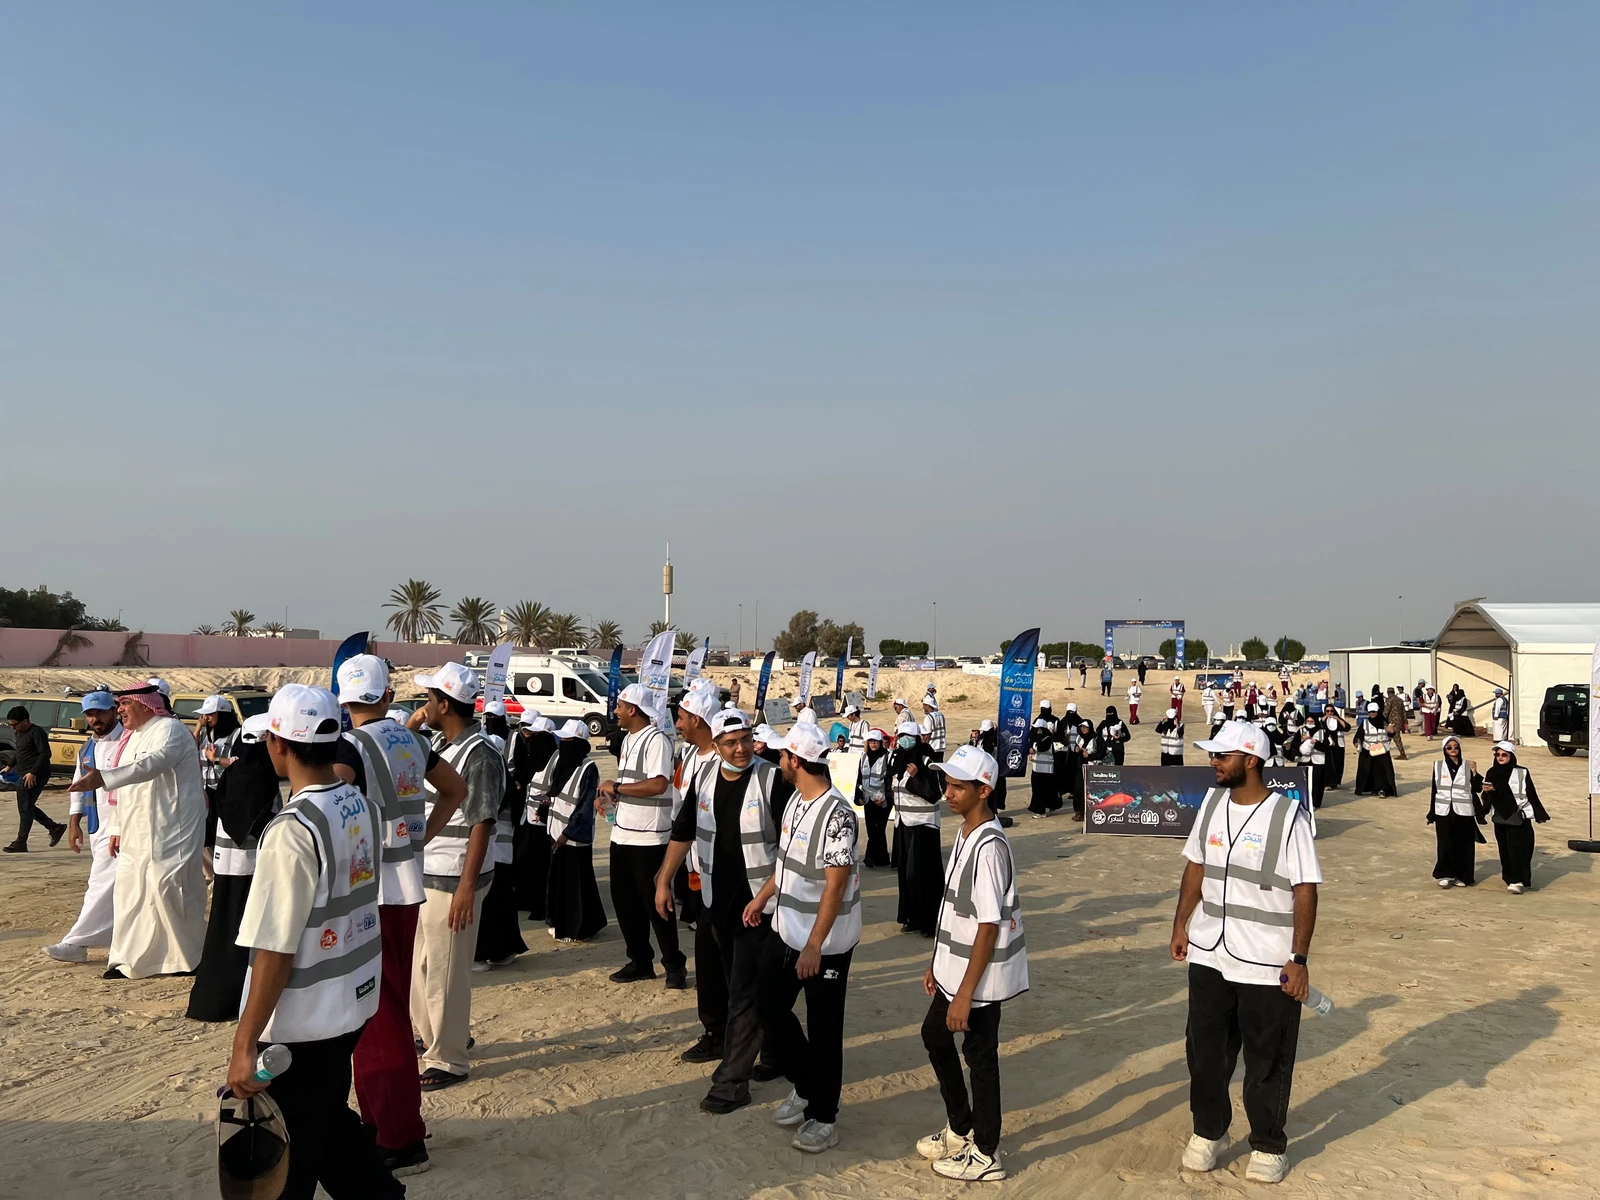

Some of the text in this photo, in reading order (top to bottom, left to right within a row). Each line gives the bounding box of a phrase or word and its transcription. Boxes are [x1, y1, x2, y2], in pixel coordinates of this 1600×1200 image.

[386, 733, 414, 750] البحر
[1266, 778, 1296, 790] عينك
[340, 798, 365, 829] البحر
